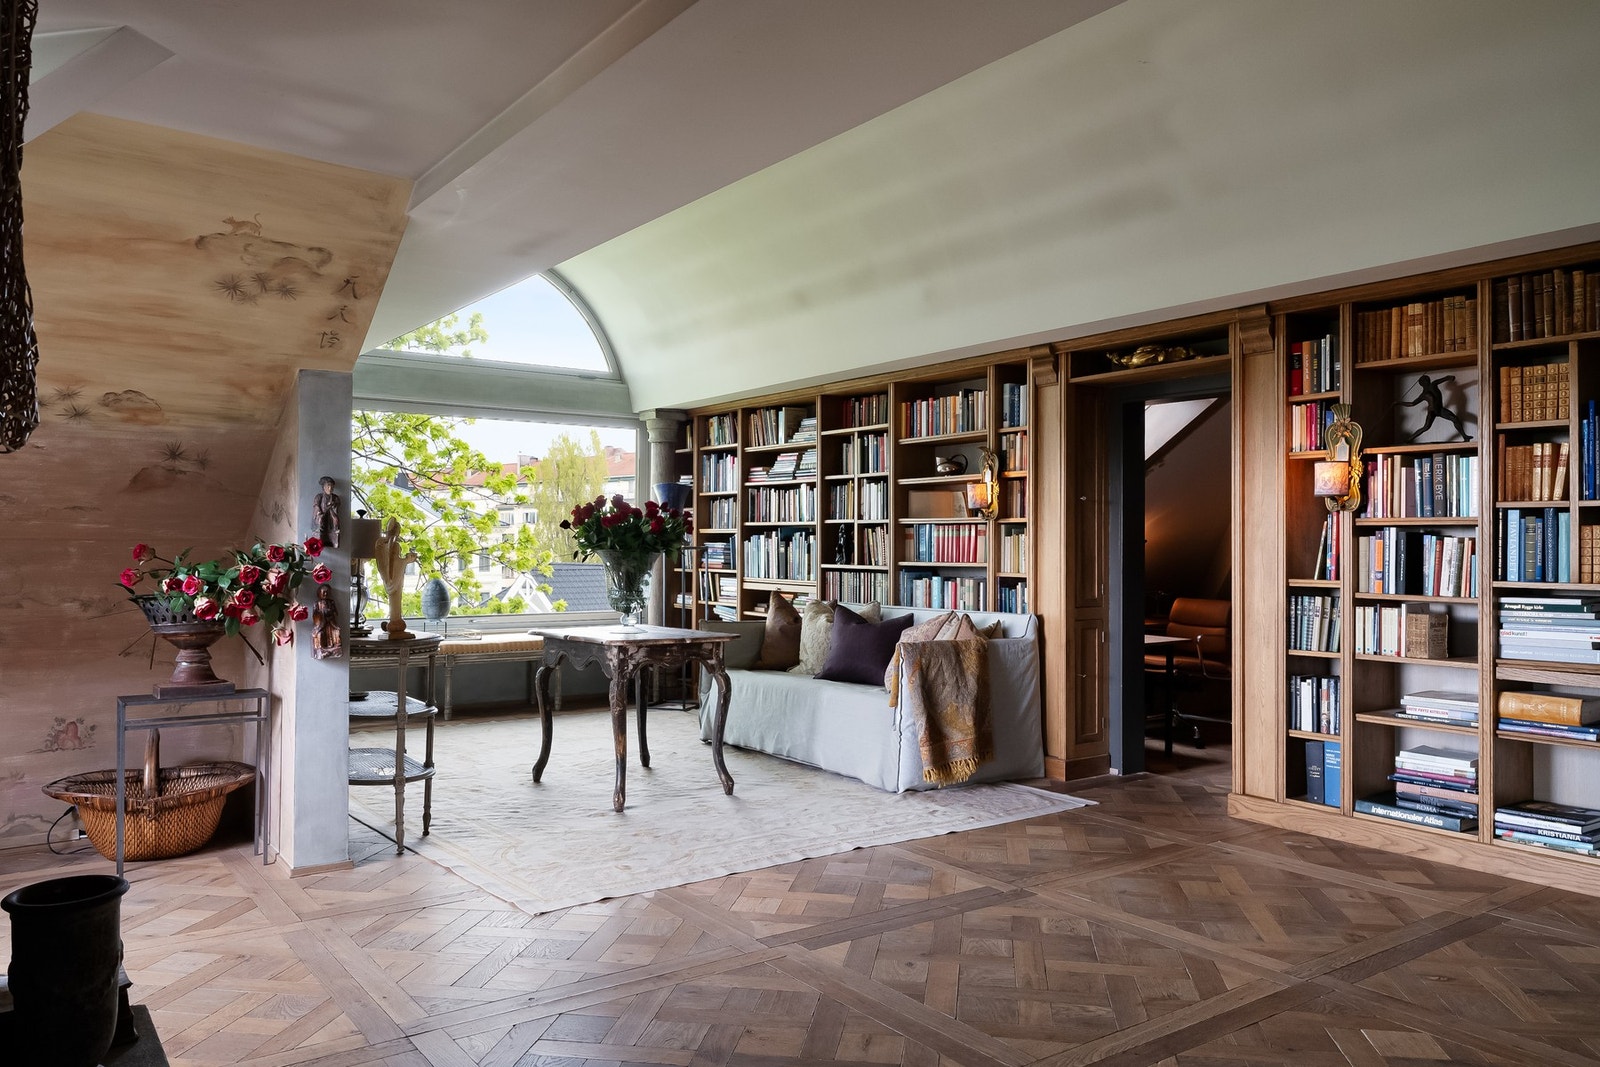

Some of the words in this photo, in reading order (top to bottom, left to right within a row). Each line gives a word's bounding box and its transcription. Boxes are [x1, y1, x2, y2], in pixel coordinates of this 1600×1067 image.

[1435, 464, 1443, 482] ERIK
[1436, 485, 1444, 500] BYE
[1416, 804, 1437, 812] ROMA
[1371, 806, 1423, 822] Internationaler
[1424, 816, 1443, 826] Atlas
[1537, 829, 1581, 842] KRISTIANIA
